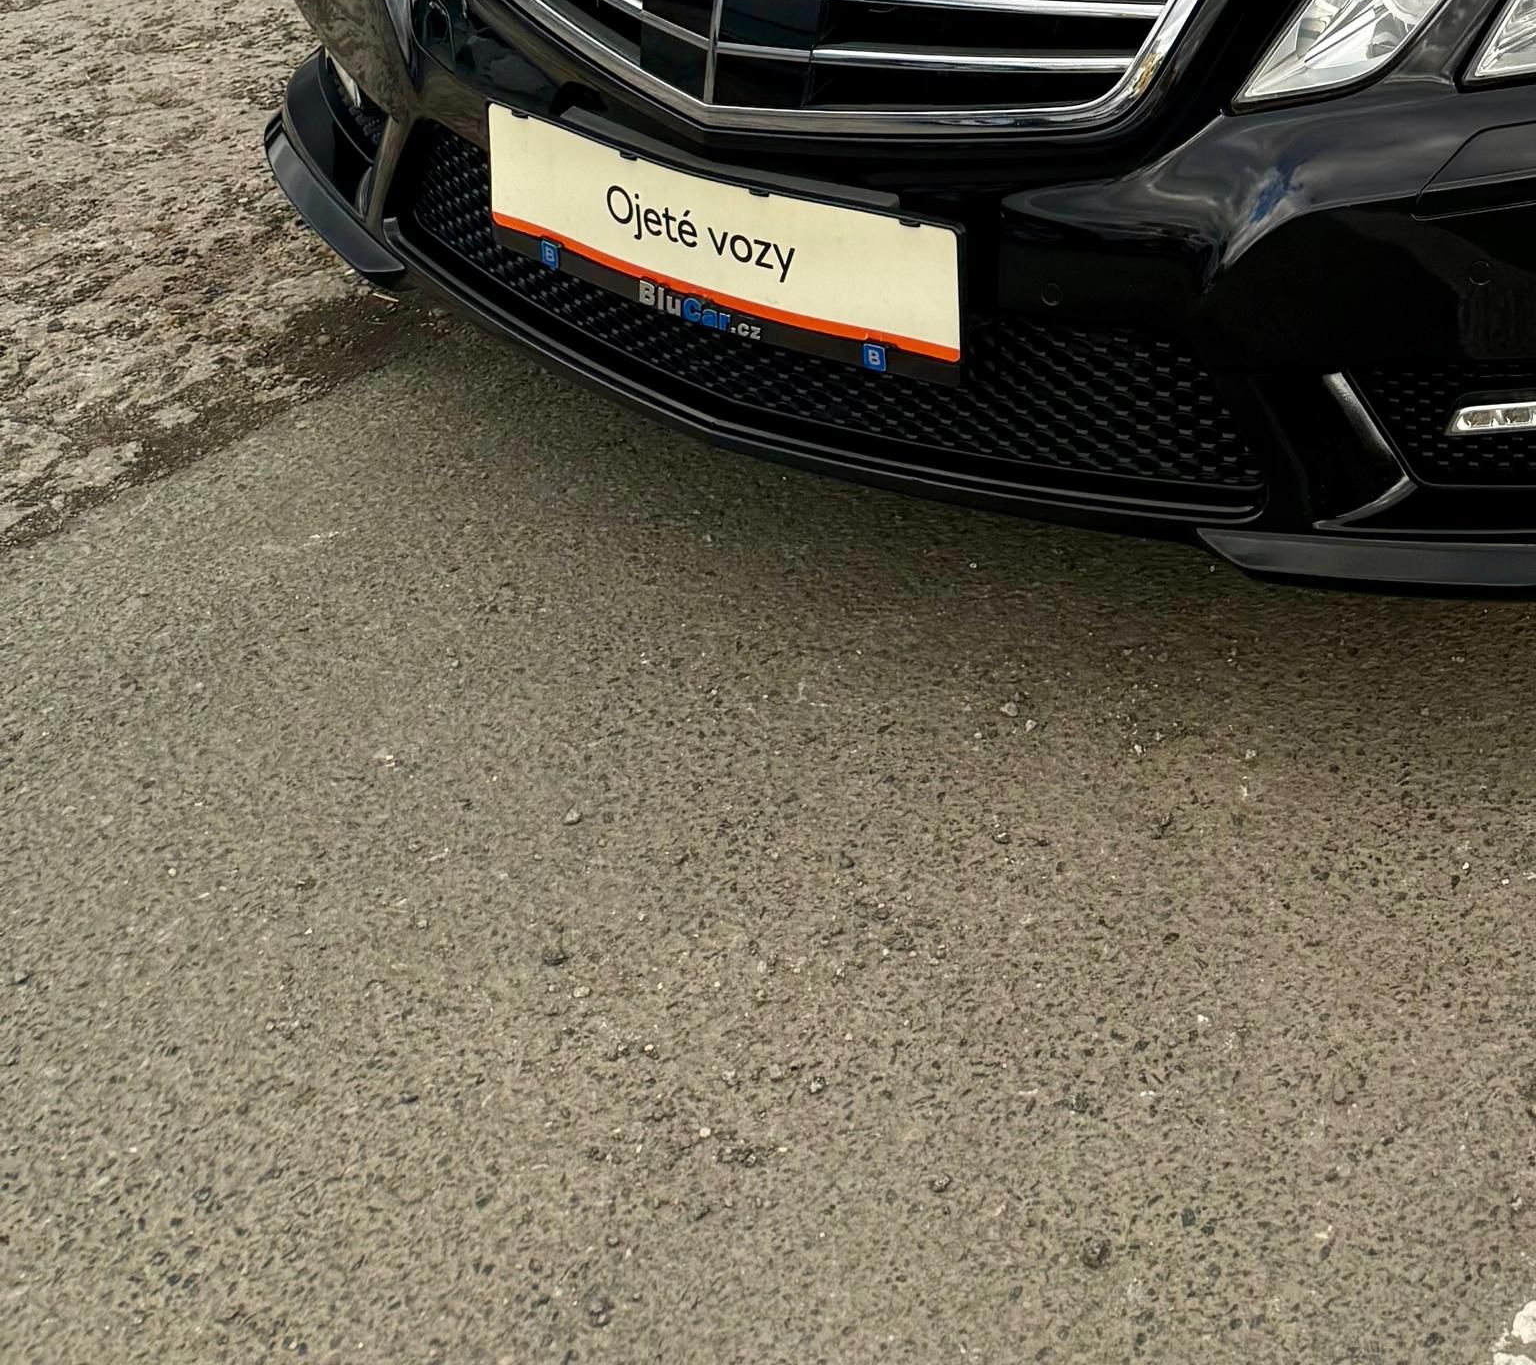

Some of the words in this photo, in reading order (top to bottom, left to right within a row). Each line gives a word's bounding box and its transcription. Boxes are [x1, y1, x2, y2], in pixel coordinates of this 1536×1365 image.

[606, 184, 698, 248] Ojeté
[707, 226, 796, 283] vozy
[639, 279, 761, 340] BluCar.cz
[868, 349, 881, 366] B
